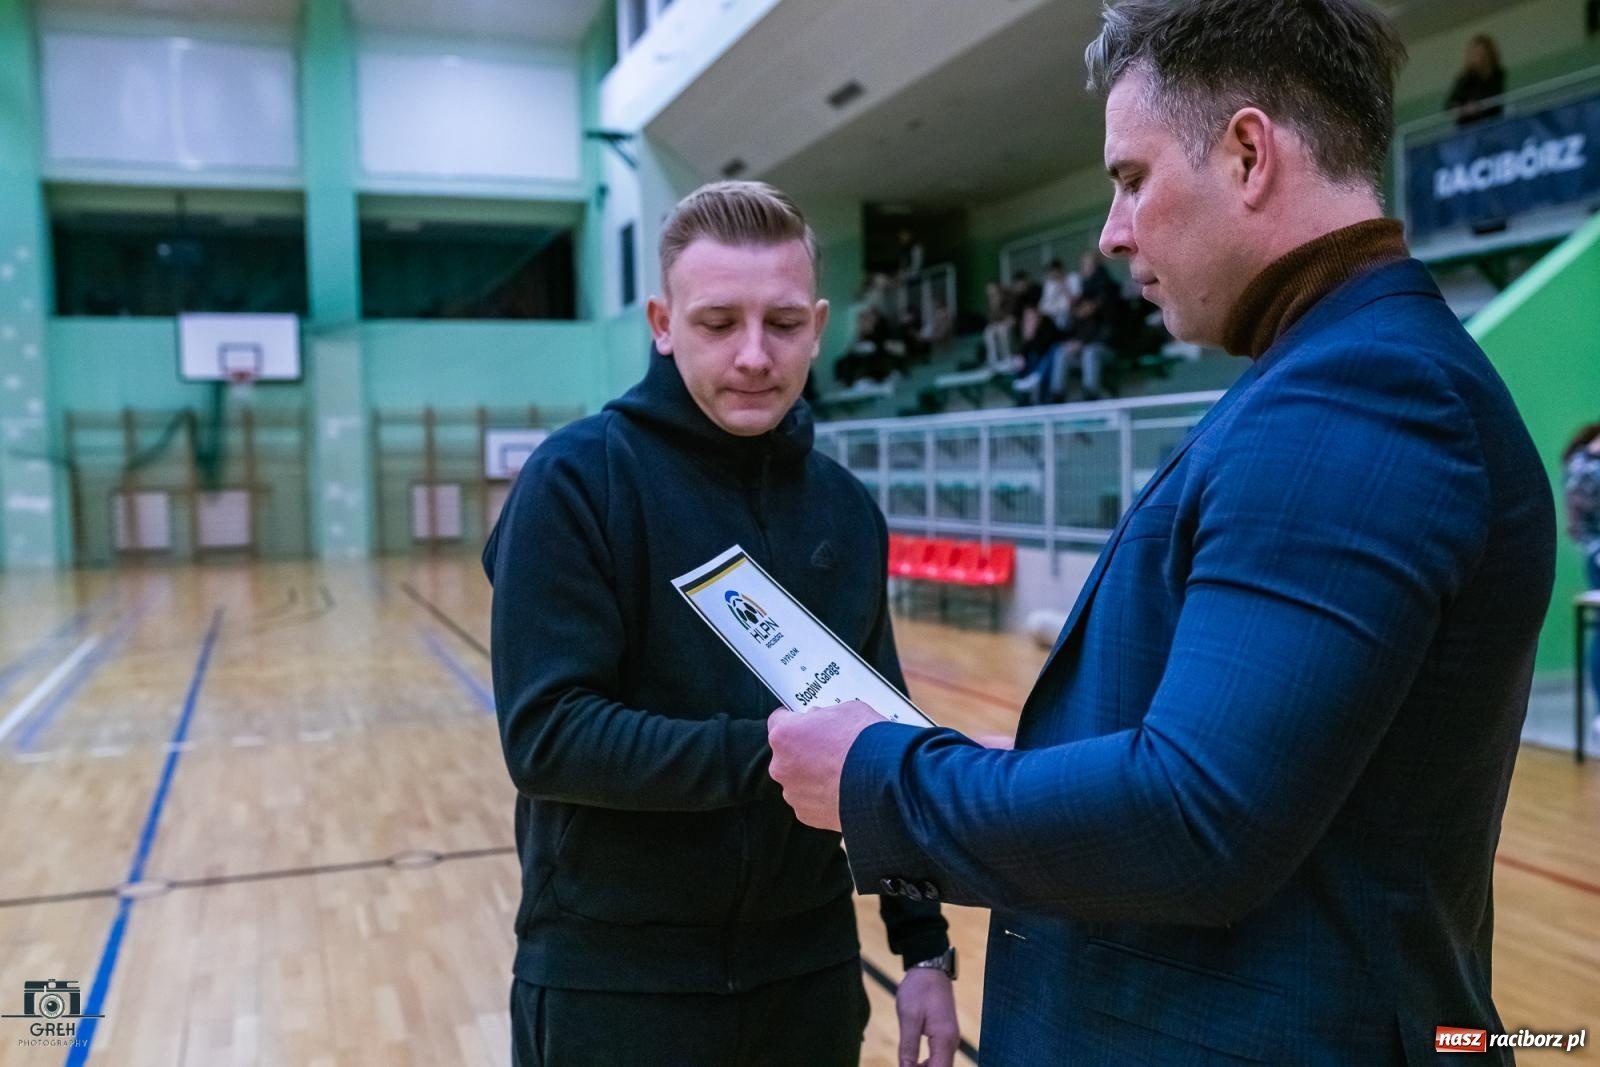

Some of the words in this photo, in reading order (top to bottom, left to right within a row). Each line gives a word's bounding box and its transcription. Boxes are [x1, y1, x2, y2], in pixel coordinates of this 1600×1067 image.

[750, 617, 779, 644] HLPN
[780, 647, 800, 665] DYPLOM
[795, 681, 822, 706] Stopiw
[814, 661, 840, 684] Garage
